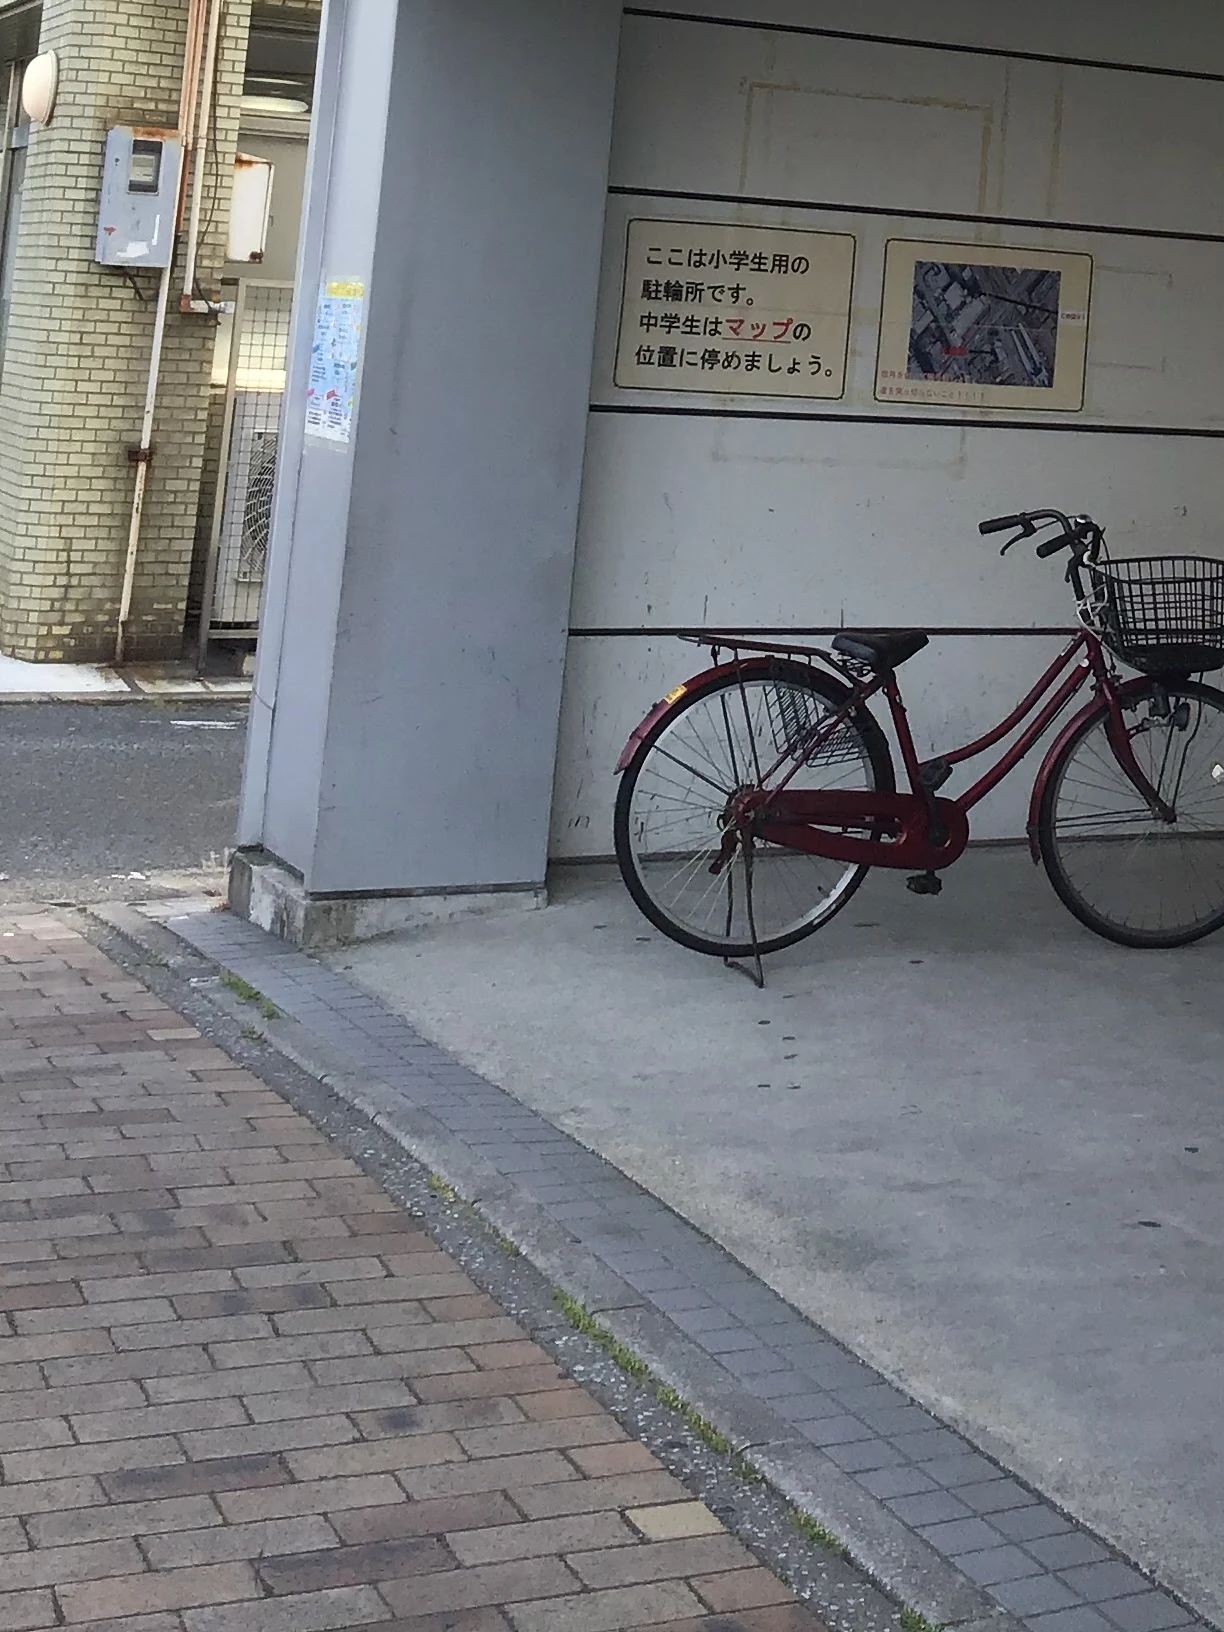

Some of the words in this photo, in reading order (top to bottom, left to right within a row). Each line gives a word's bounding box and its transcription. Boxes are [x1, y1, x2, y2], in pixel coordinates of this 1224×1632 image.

[645, 245, 811, 275] ここは小学生用の
[640, 278, 757, 308] 駐輪所です。
[639, 312, 812, 343] 中学生はマップの
[635, 344, 834, 380] 位置に停めましょう。
